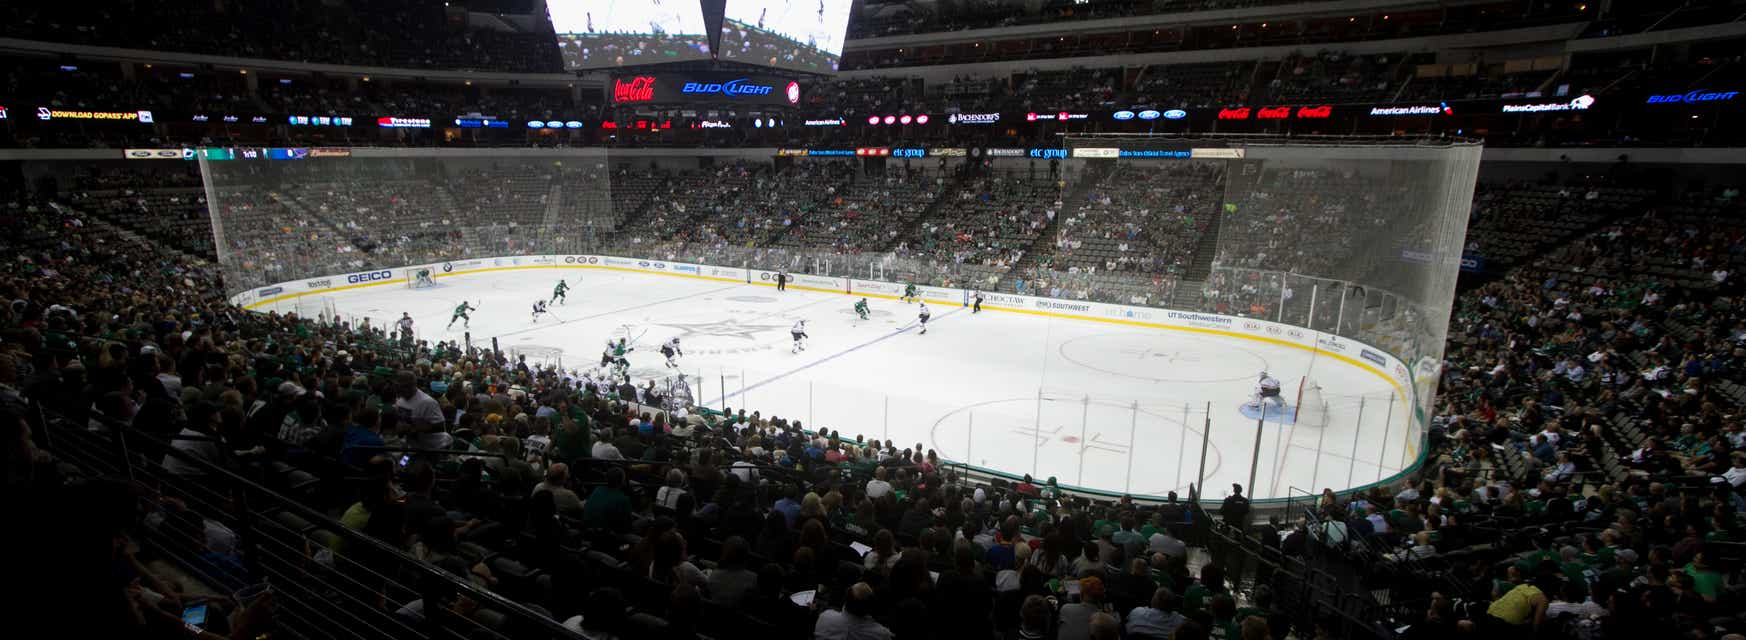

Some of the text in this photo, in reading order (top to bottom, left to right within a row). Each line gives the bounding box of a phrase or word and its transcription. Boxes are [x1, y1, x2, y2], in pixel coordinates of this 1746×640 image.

[682, 82, 721, 94] BUD
[730, 83, 773, 95] LIGHT
[1647, 91, 1739, 103] BUD LIGHT
[52, 110, 92, 119] DOWNLOAD
[123, 112, 137, 120] APP
[1370, 106, 1440, 115] American Airlines
[1044, 149, 1068, 159] group
[348, 270, 392, 284] GEICO
[1177, 313, 1232, 324] Southwestern
